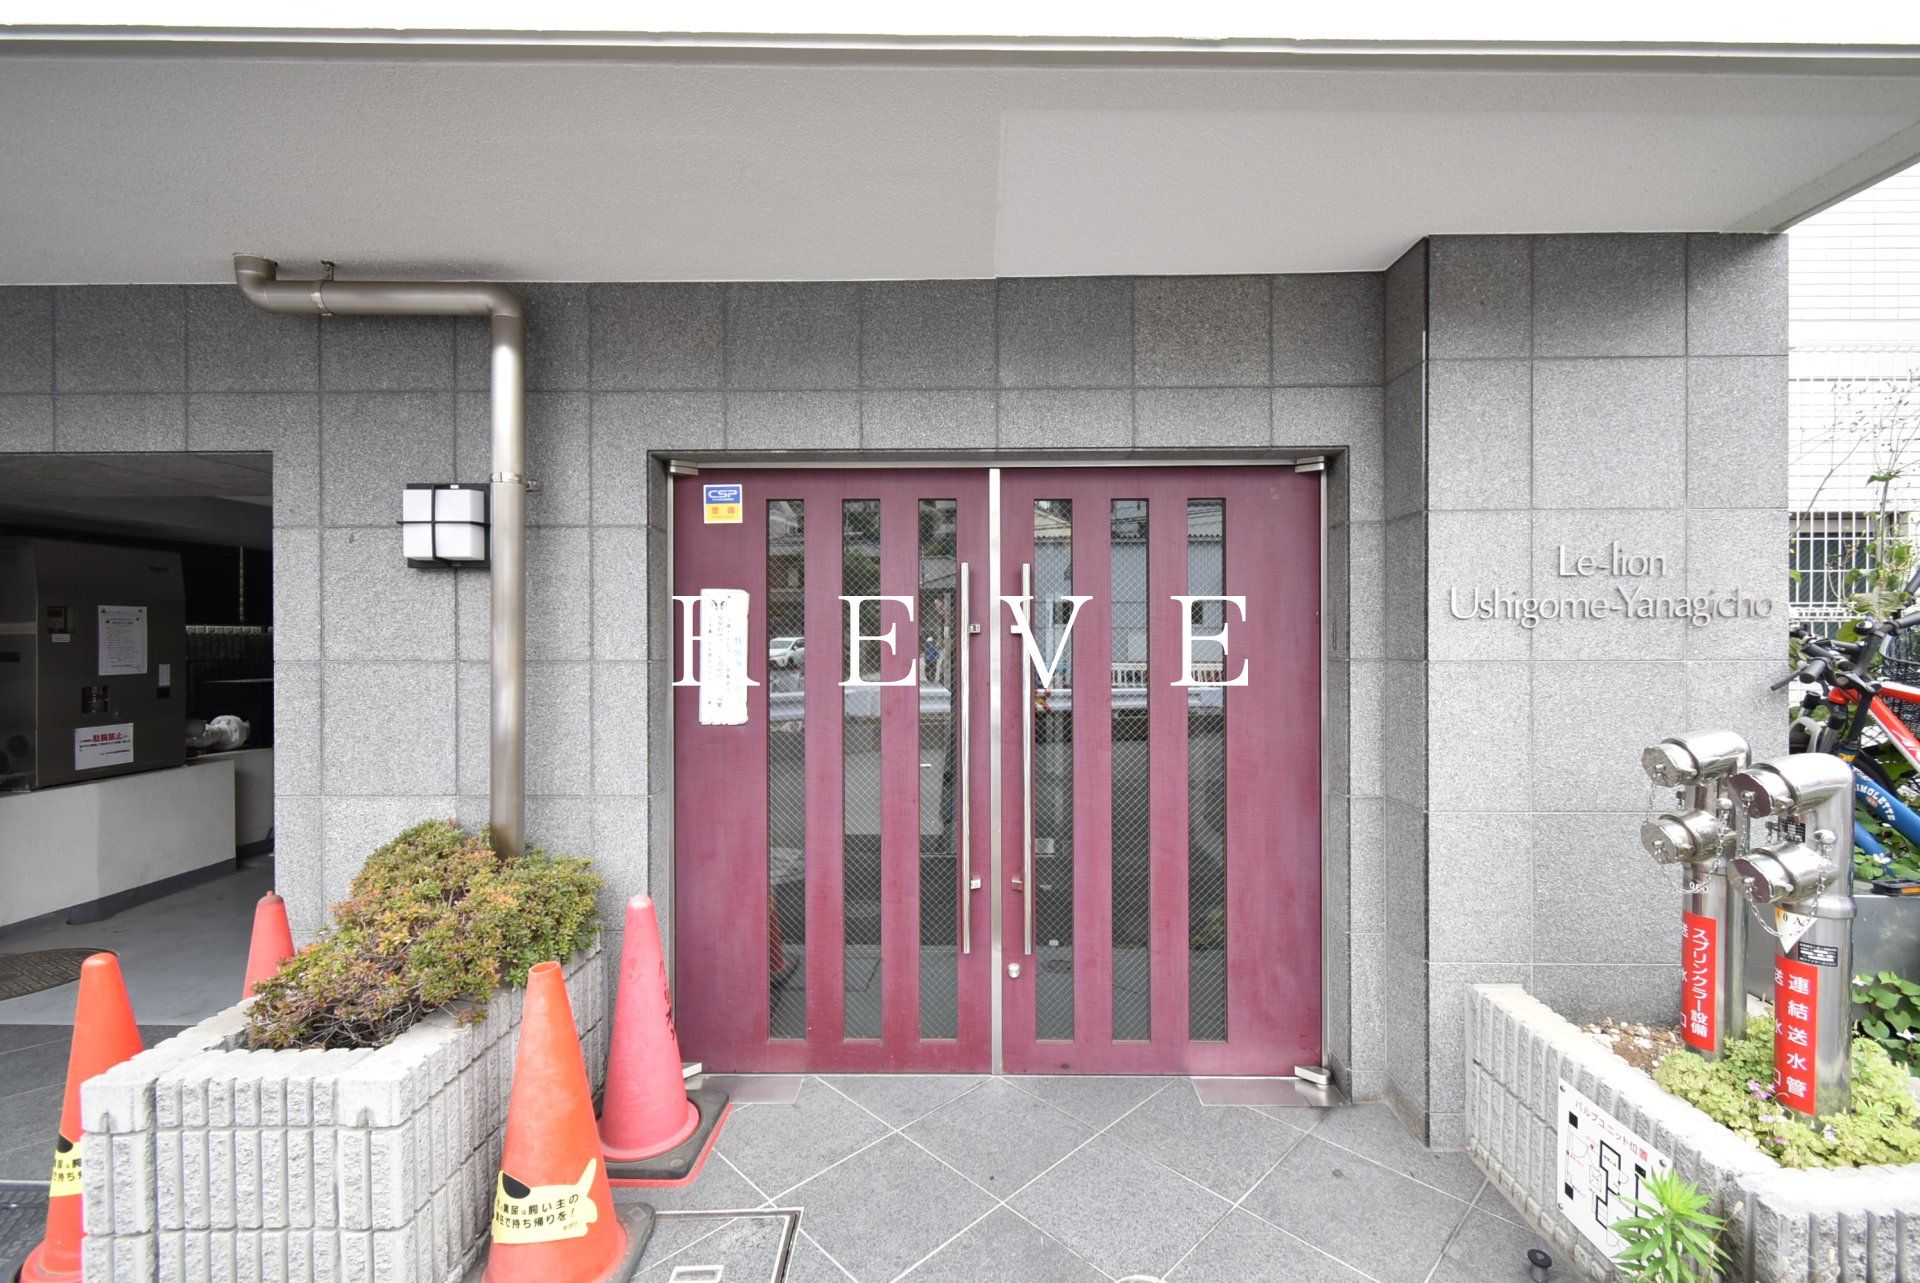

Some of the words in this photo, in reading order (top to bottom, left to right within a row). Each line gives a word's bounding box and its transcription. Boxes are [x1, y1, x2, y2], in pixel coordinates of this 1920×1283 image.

[708, 489, 738, 499] CSP
[1558, 541, 1668, 577] Le-lion
[1449, 586, 1775, 629] Ushigome-Yanagicho
[1690, 927, 1709, 1038] スプリンクラー設備
[1786, 973, 1810, 1098] 連結送水管
